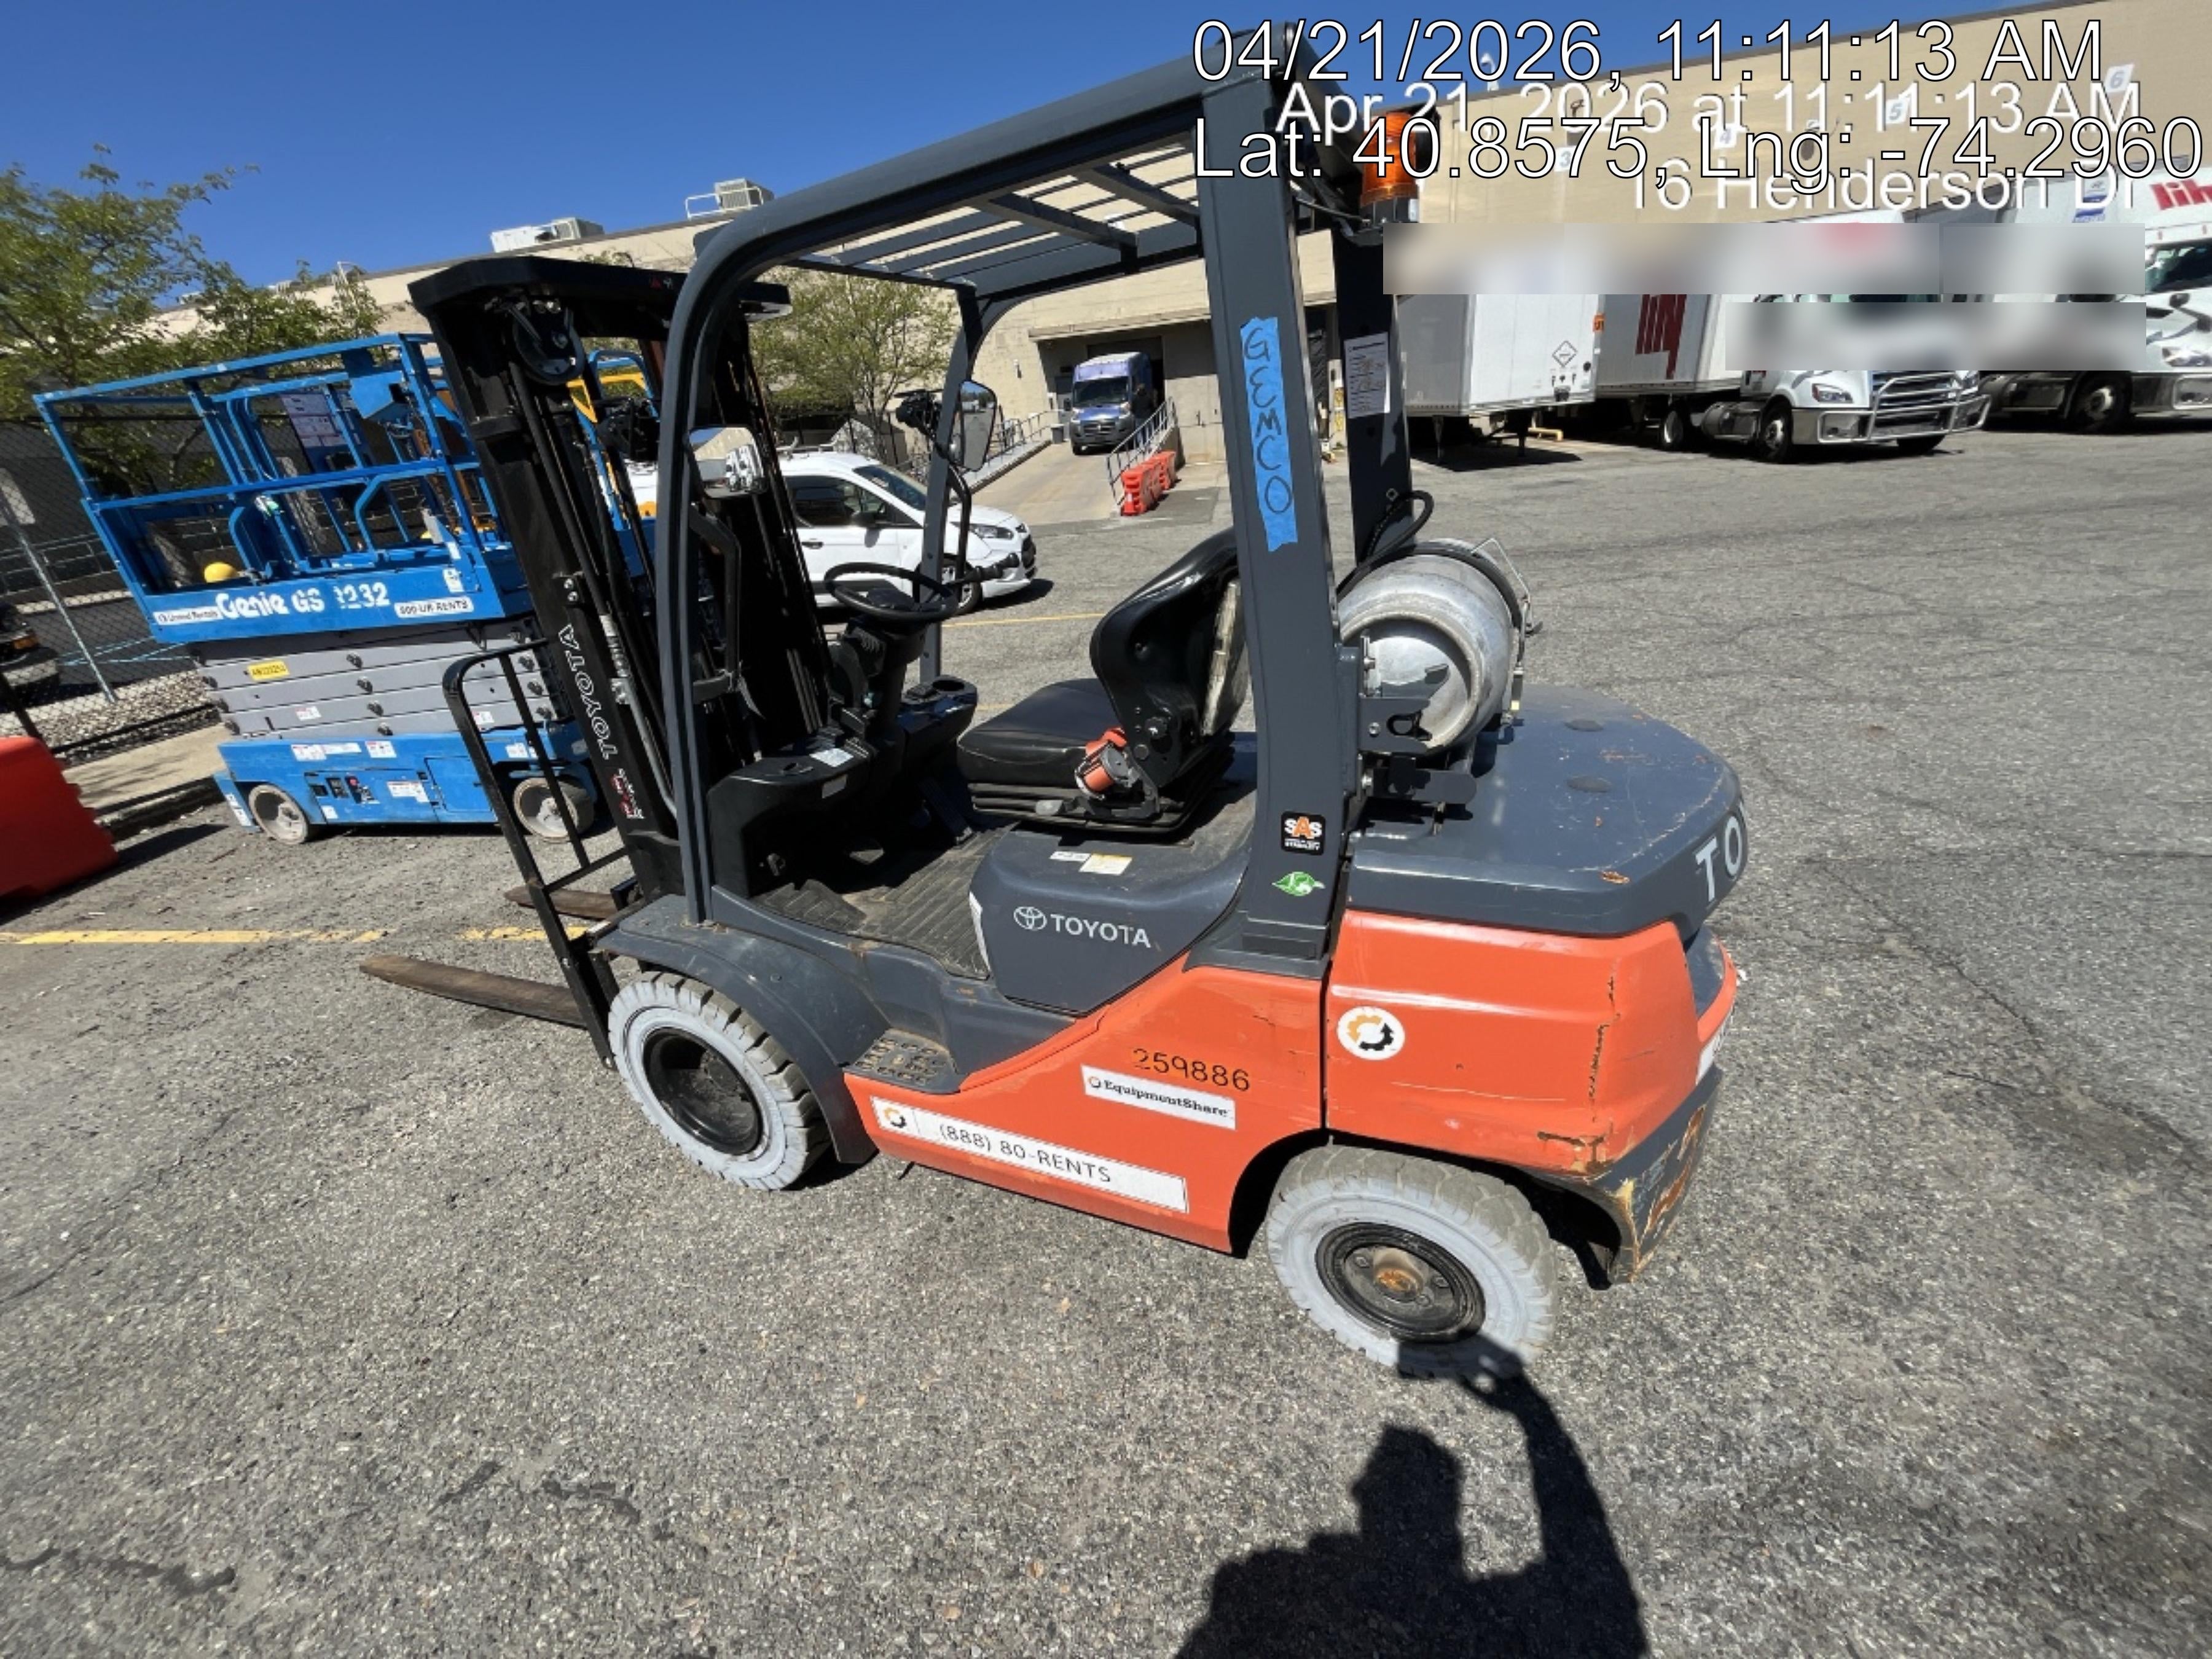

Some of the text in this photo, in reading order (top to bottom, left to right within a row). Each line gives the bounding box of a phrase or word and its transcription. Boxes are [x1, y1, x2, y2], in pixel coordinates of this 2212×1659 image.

[2110, 70, 2124, 89] 6
[1244, 327, 1292, 514] GEMCO
[215, 591, 290, 619] Genie
[291, 587, 325, 613] GS
[558, 623, 618, 761] TOYOTA
[1284, 816, 1322, 839] SAS
[1050, 914, 1151, 949] TOYOTA
[1133, 1048, 1250, 1091] 259886
[1104, 1080, 1229, 1117] EquipmentShare
[939, 1124, 1112, 1183] (888) 80-RENTS
